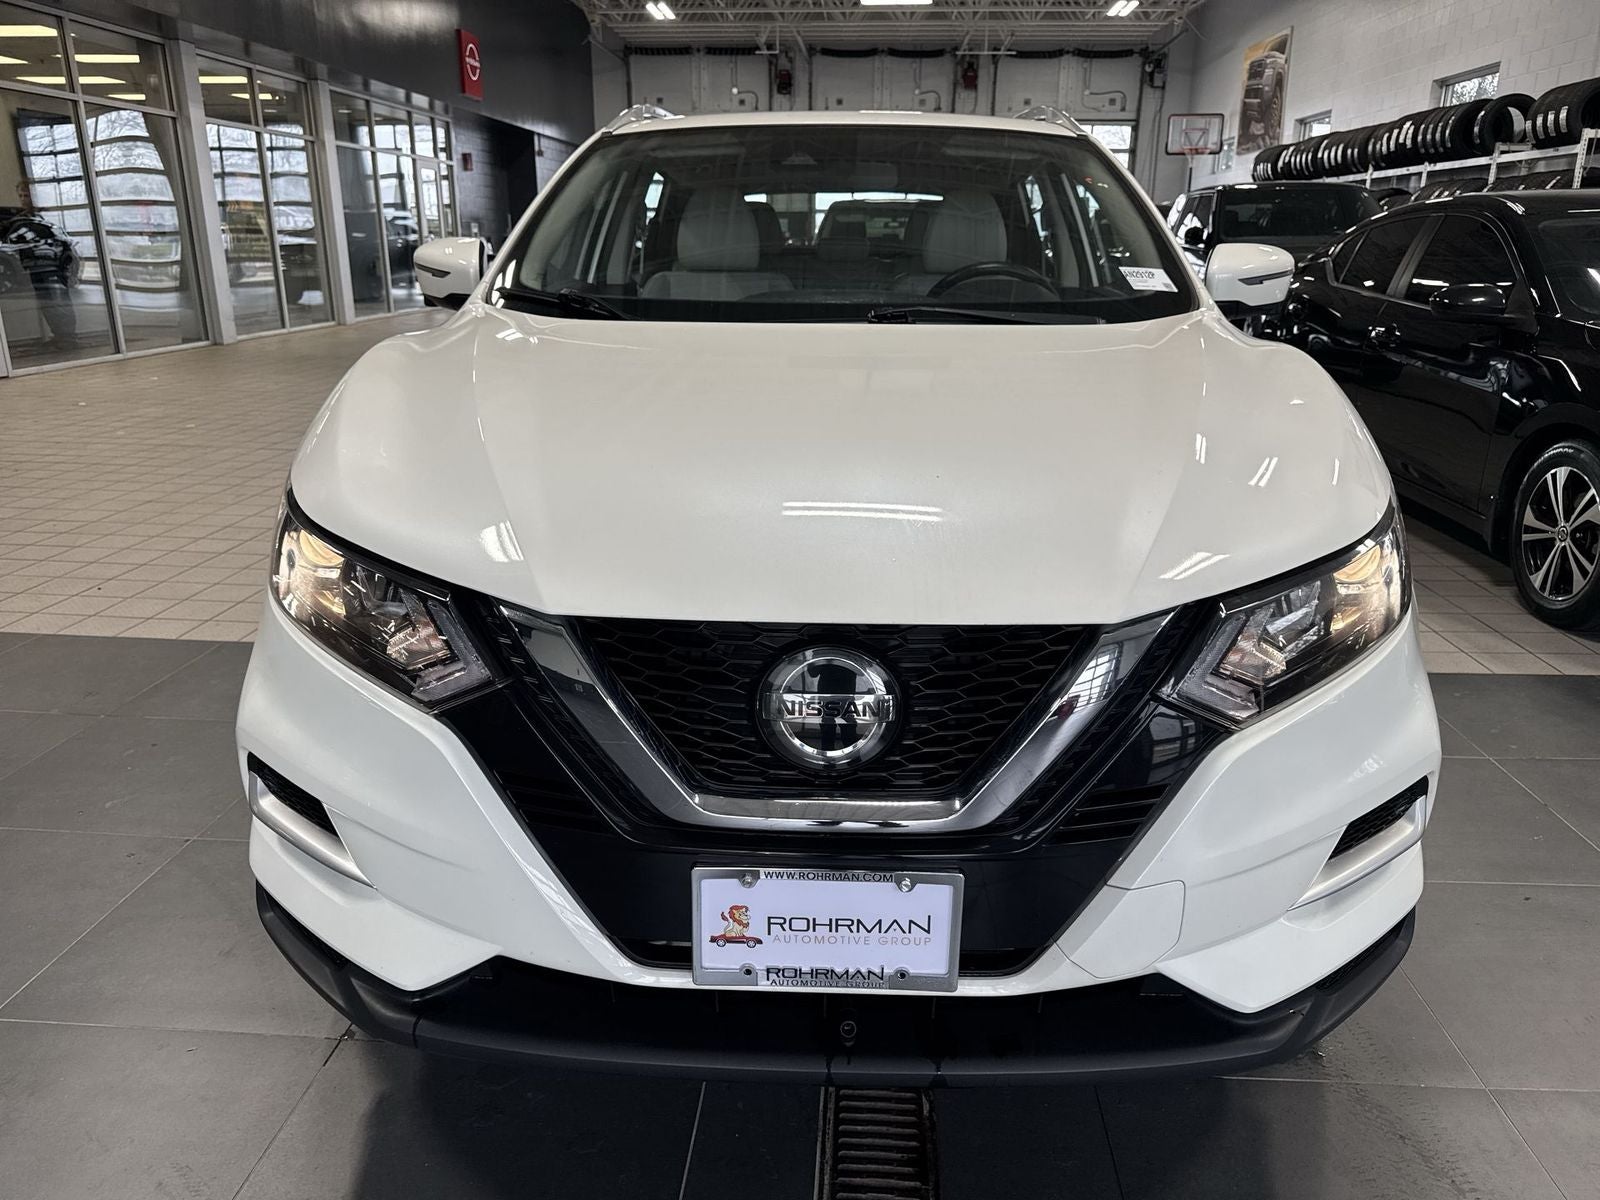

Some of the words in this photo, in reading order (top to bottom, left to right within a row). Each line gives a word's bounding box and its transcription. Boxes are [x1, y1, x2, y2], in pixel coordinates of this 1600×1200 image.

[779, 699, 882, 718] NISSAN
[763, 871, 894, 883] WWW.ROHRMAN.COM
[767, 915, 932, 936] ROHRMAN
[772, 934, 871, 946] AUTOMOTIVE
[878, 936, 932, 947] GROUP
[766, 966, 885, 981] ROHRMAN
[770, 979, 842, 987] AUTOMOTIVE
